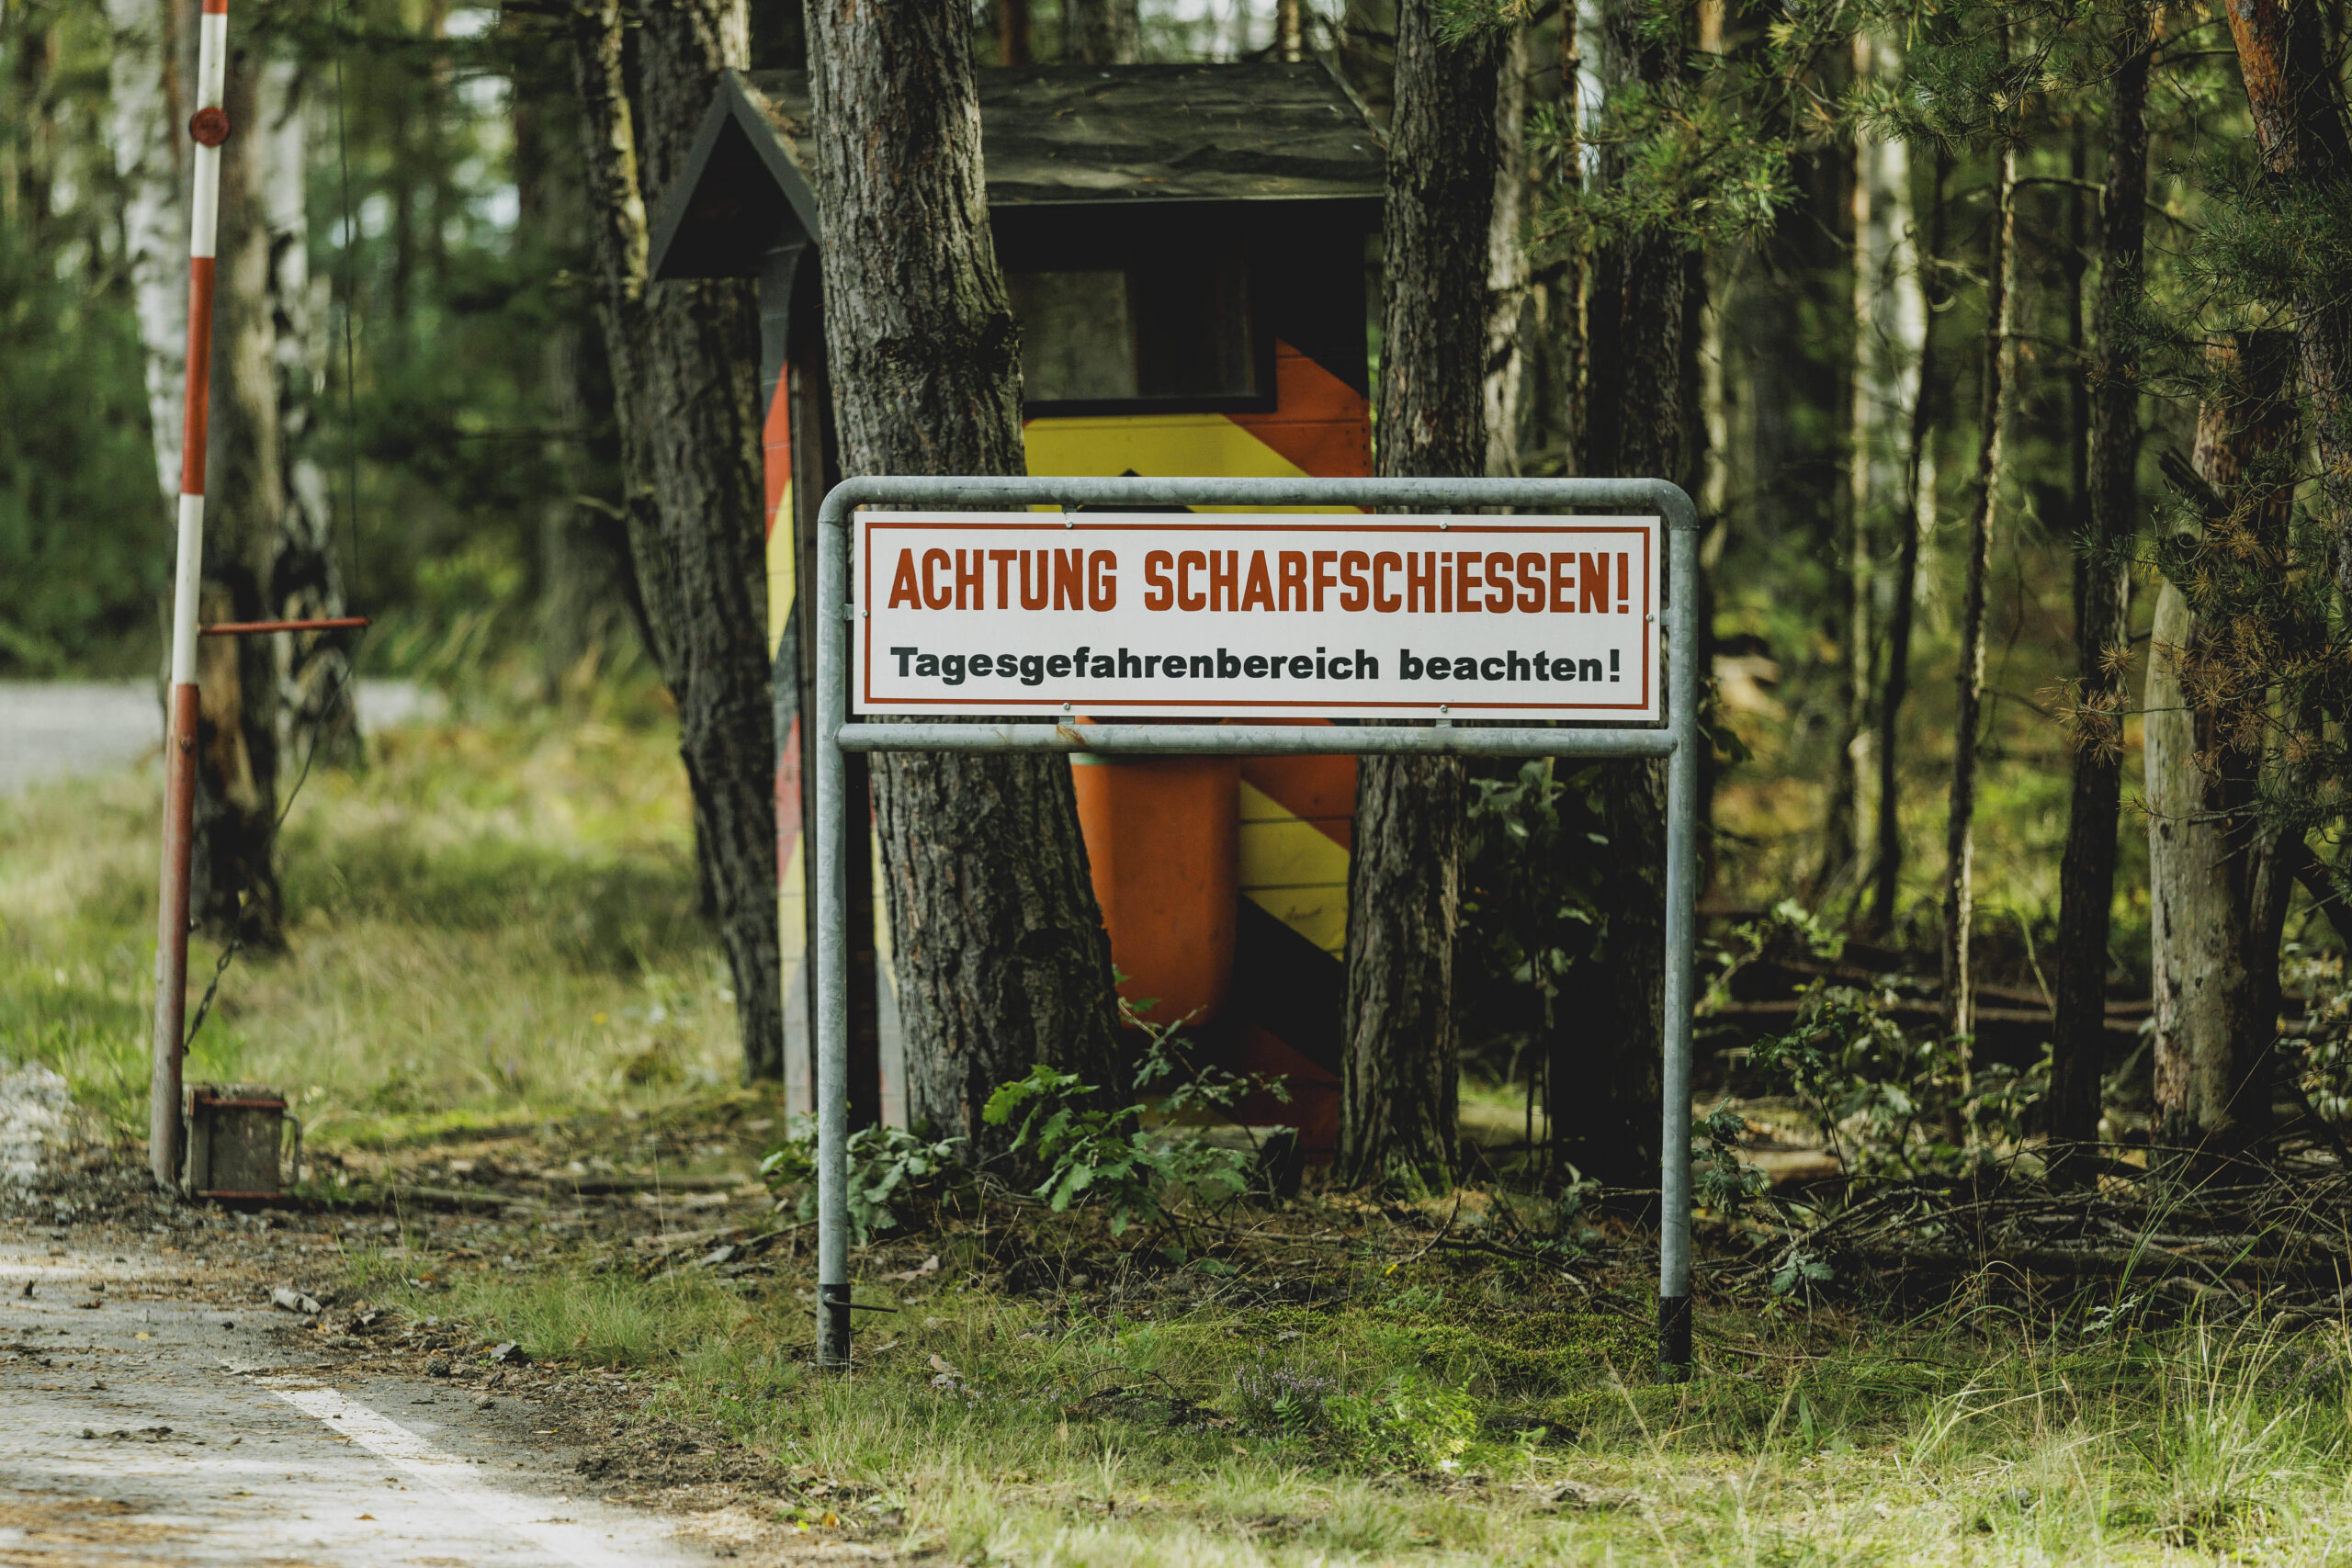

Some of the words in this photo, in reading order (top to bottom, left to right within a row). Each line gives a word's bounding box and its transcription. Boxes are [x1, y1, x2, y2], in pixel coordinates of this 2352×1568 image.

[888, 547, 1117, 612] ACHTUNG
[890, 646, 1379, 686] Tagesgefahrenbereich
[1399, 649, 1620, 682] beachten!
